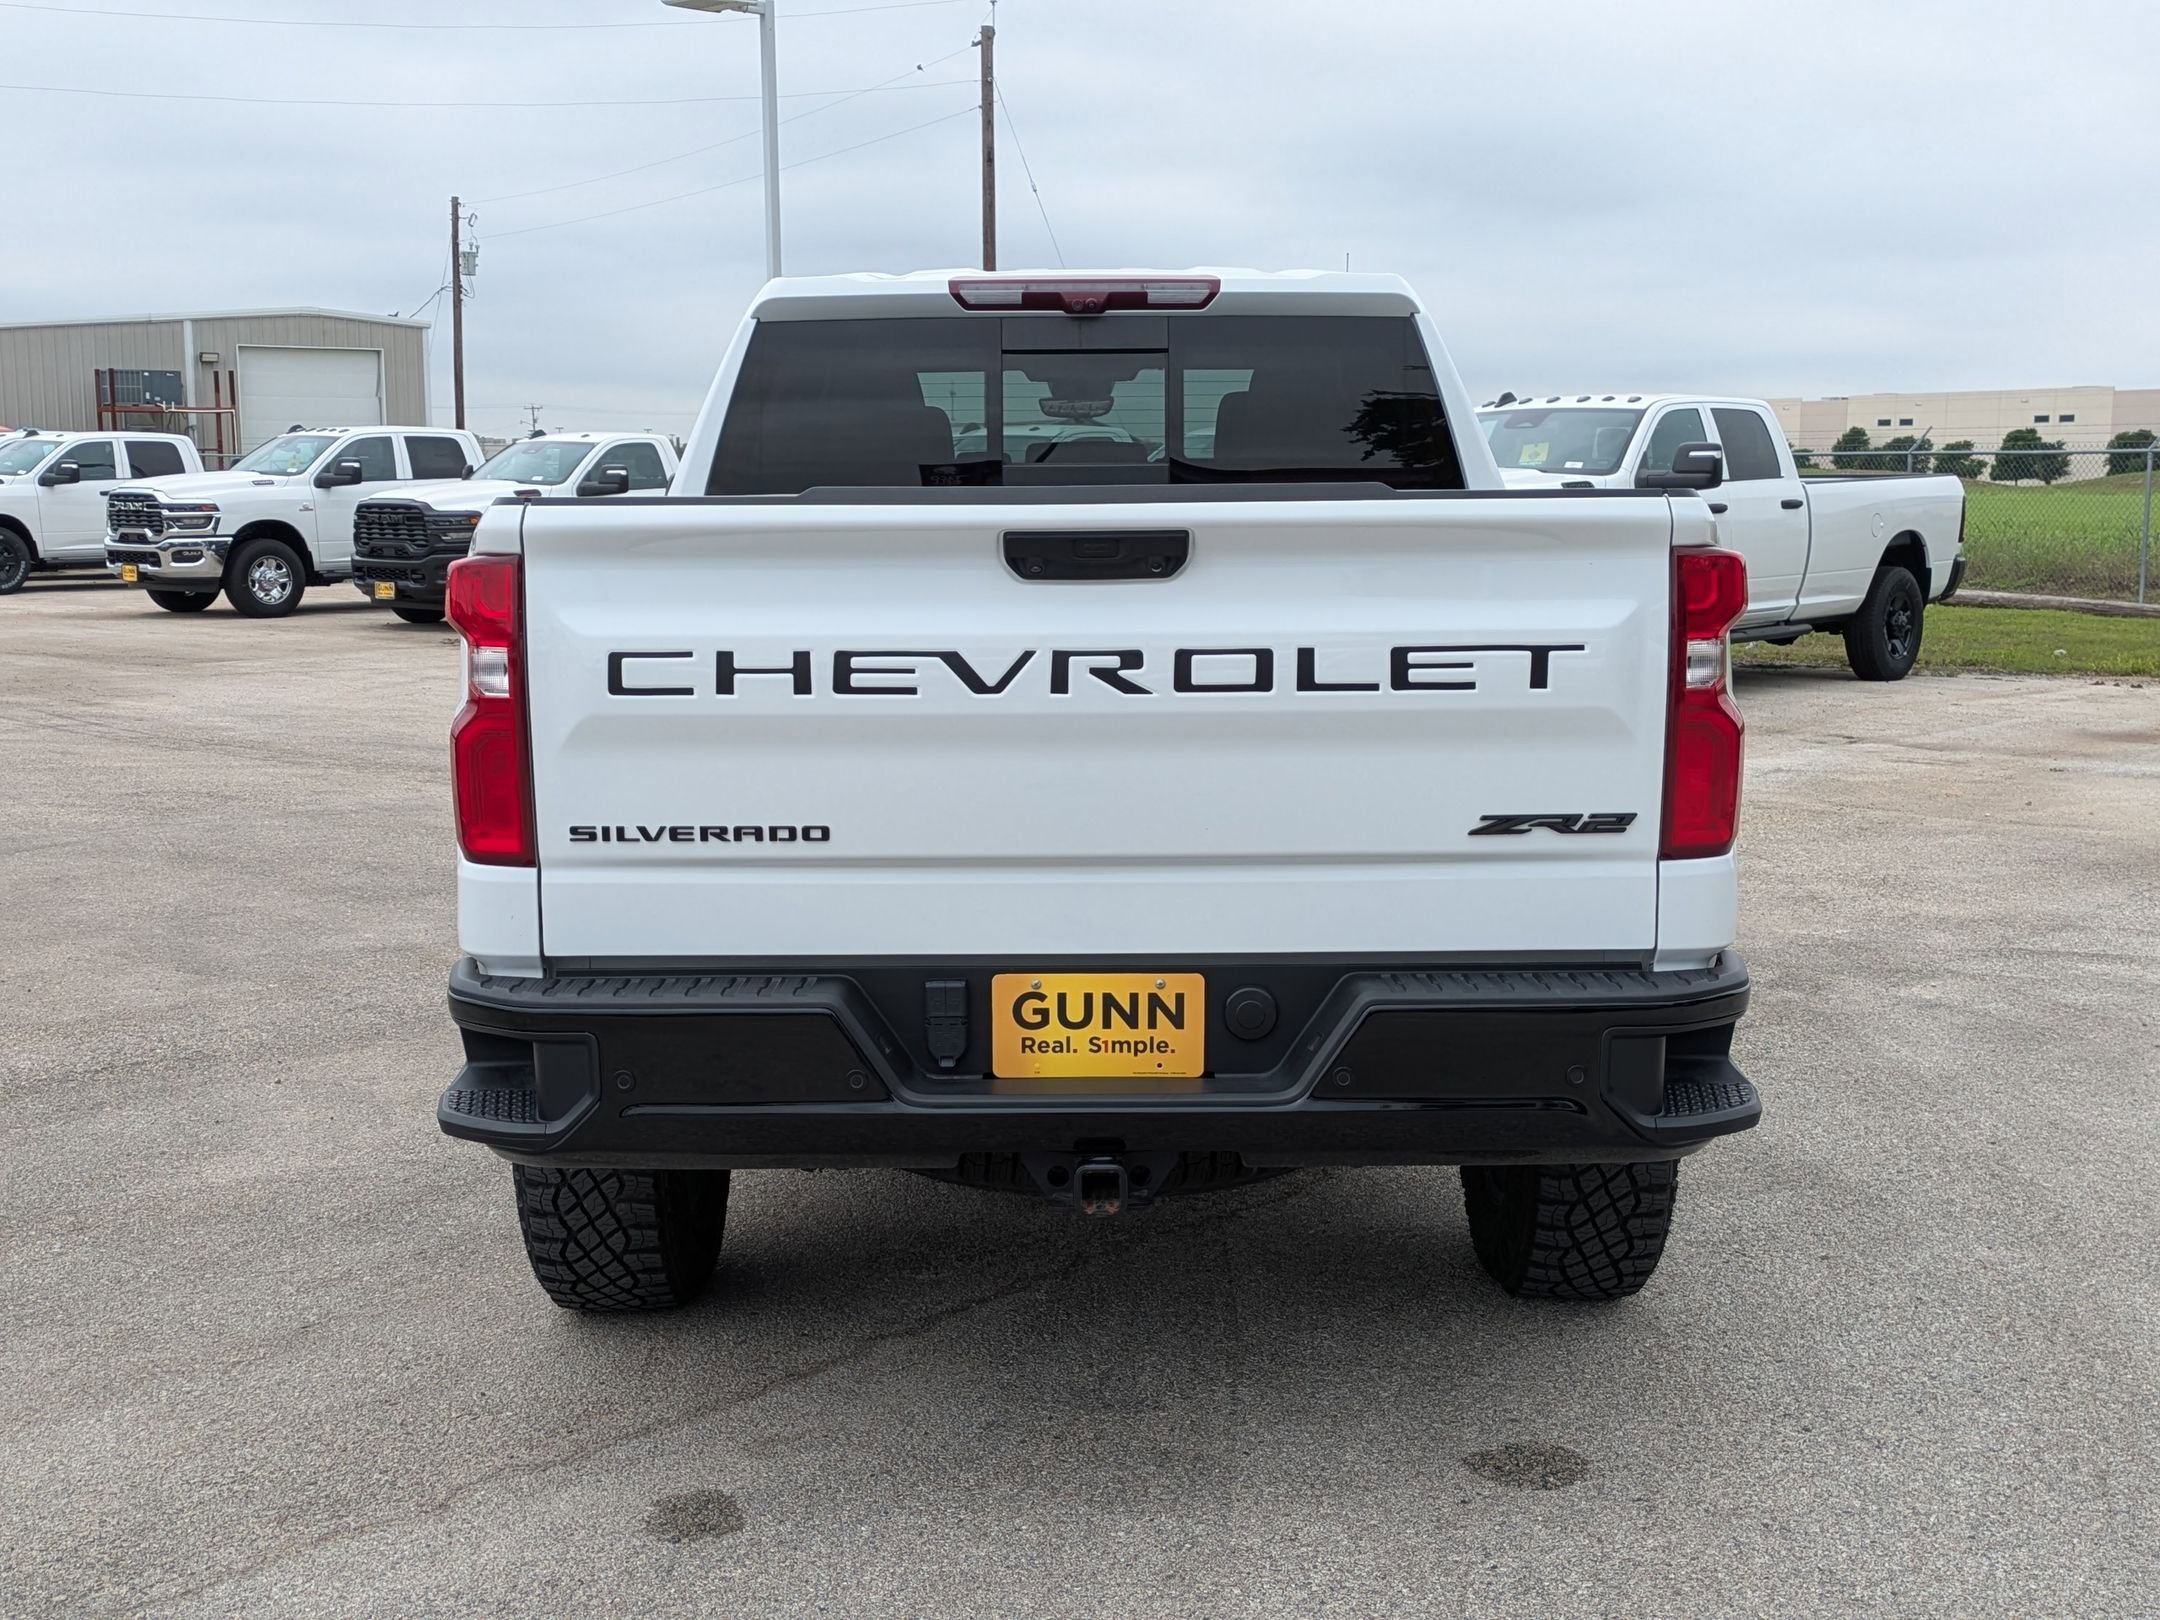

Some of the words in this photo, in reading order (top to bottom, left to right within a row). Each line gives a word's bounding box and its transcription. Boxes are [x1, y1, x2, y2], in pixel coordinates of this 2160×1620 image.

[367, 513, 404, 524] RAM
[607, 644, 1585, 696] CHEVROLET
[569, 825, 831, 843] SILVERADO
[1467, 812, 1638, 836] ZR2
[1012, 990, 1185, 1031] GUNN
[1021, 1035, 1078, 1054] Real.
